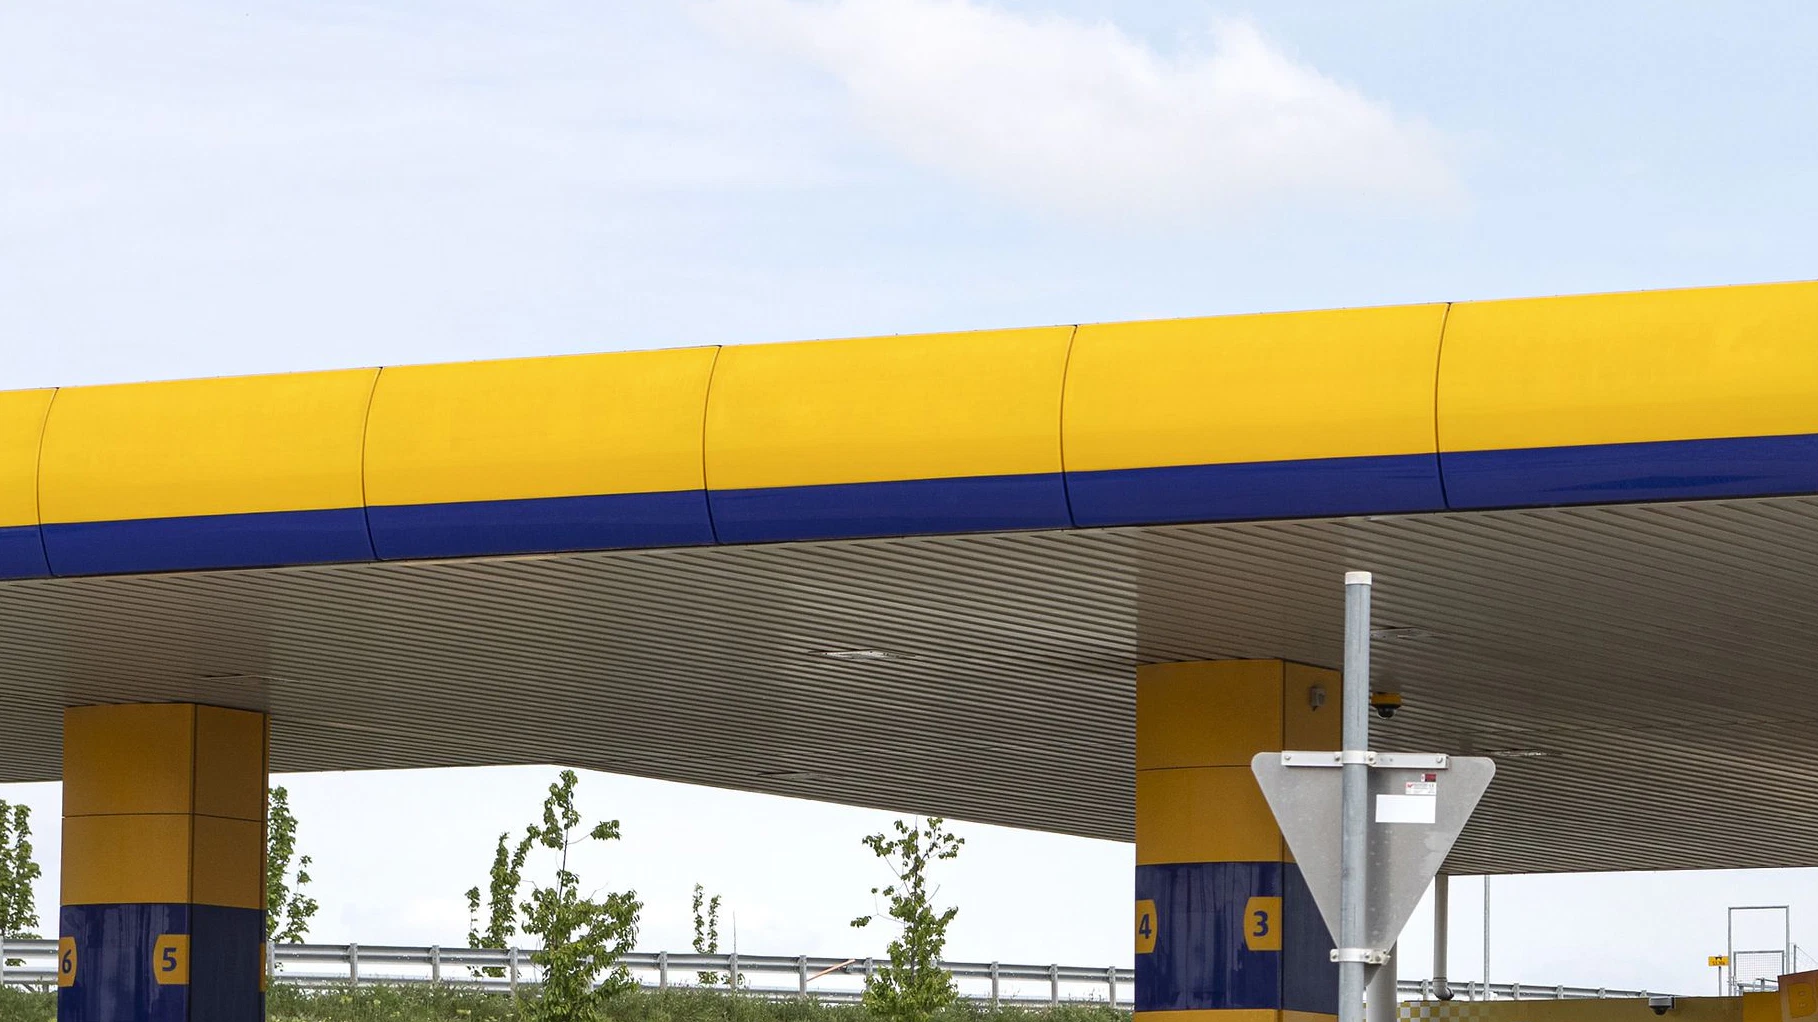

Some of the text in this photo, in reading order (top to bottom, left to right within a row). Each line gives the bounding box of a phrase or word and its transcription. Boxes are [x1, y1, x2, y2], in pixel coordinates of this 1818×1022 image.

[1138, 913, 1152, 939] 4
[1252, 910, 1269, 937] 3
[61, 949, 72, 974] 6
[161, 947, 177, 972] 5
